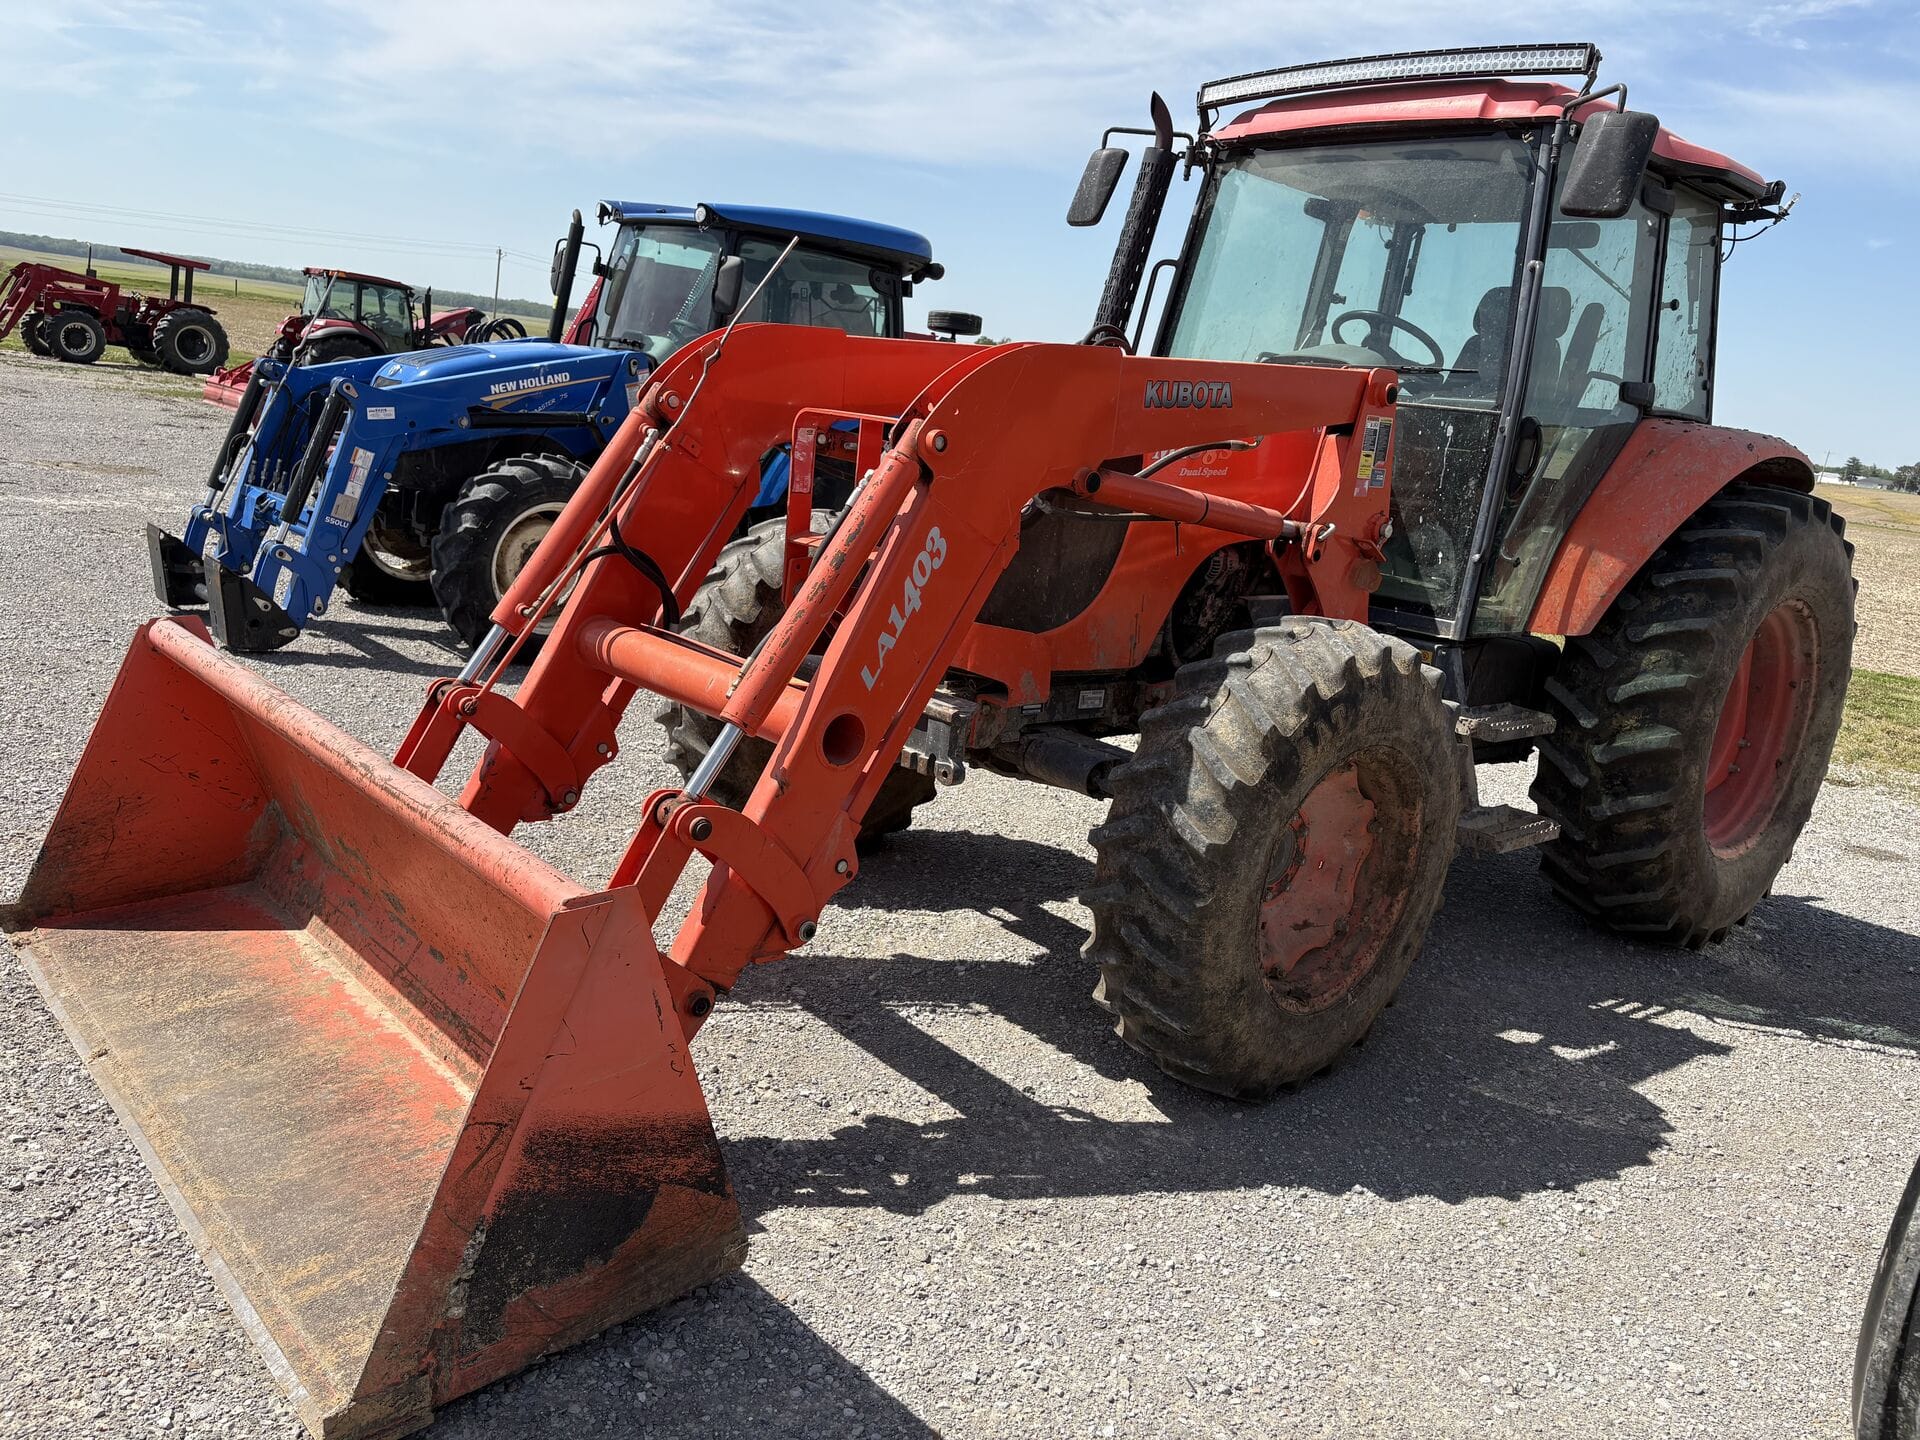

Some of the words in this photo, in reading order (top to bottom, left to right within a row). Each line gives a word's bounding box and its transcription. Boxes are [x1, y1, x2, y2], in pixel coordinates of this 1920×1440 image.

[490, 381, 516, 395] NEW
[519, 372, 570, 389] HOLLAND
[1144, 380, 1233, 409] KUBOTA
[1179, 467, 1200, 476] Dual
[1201, 467, 1228, 477] Speed
[860, 526, 947, 692] LA1403
